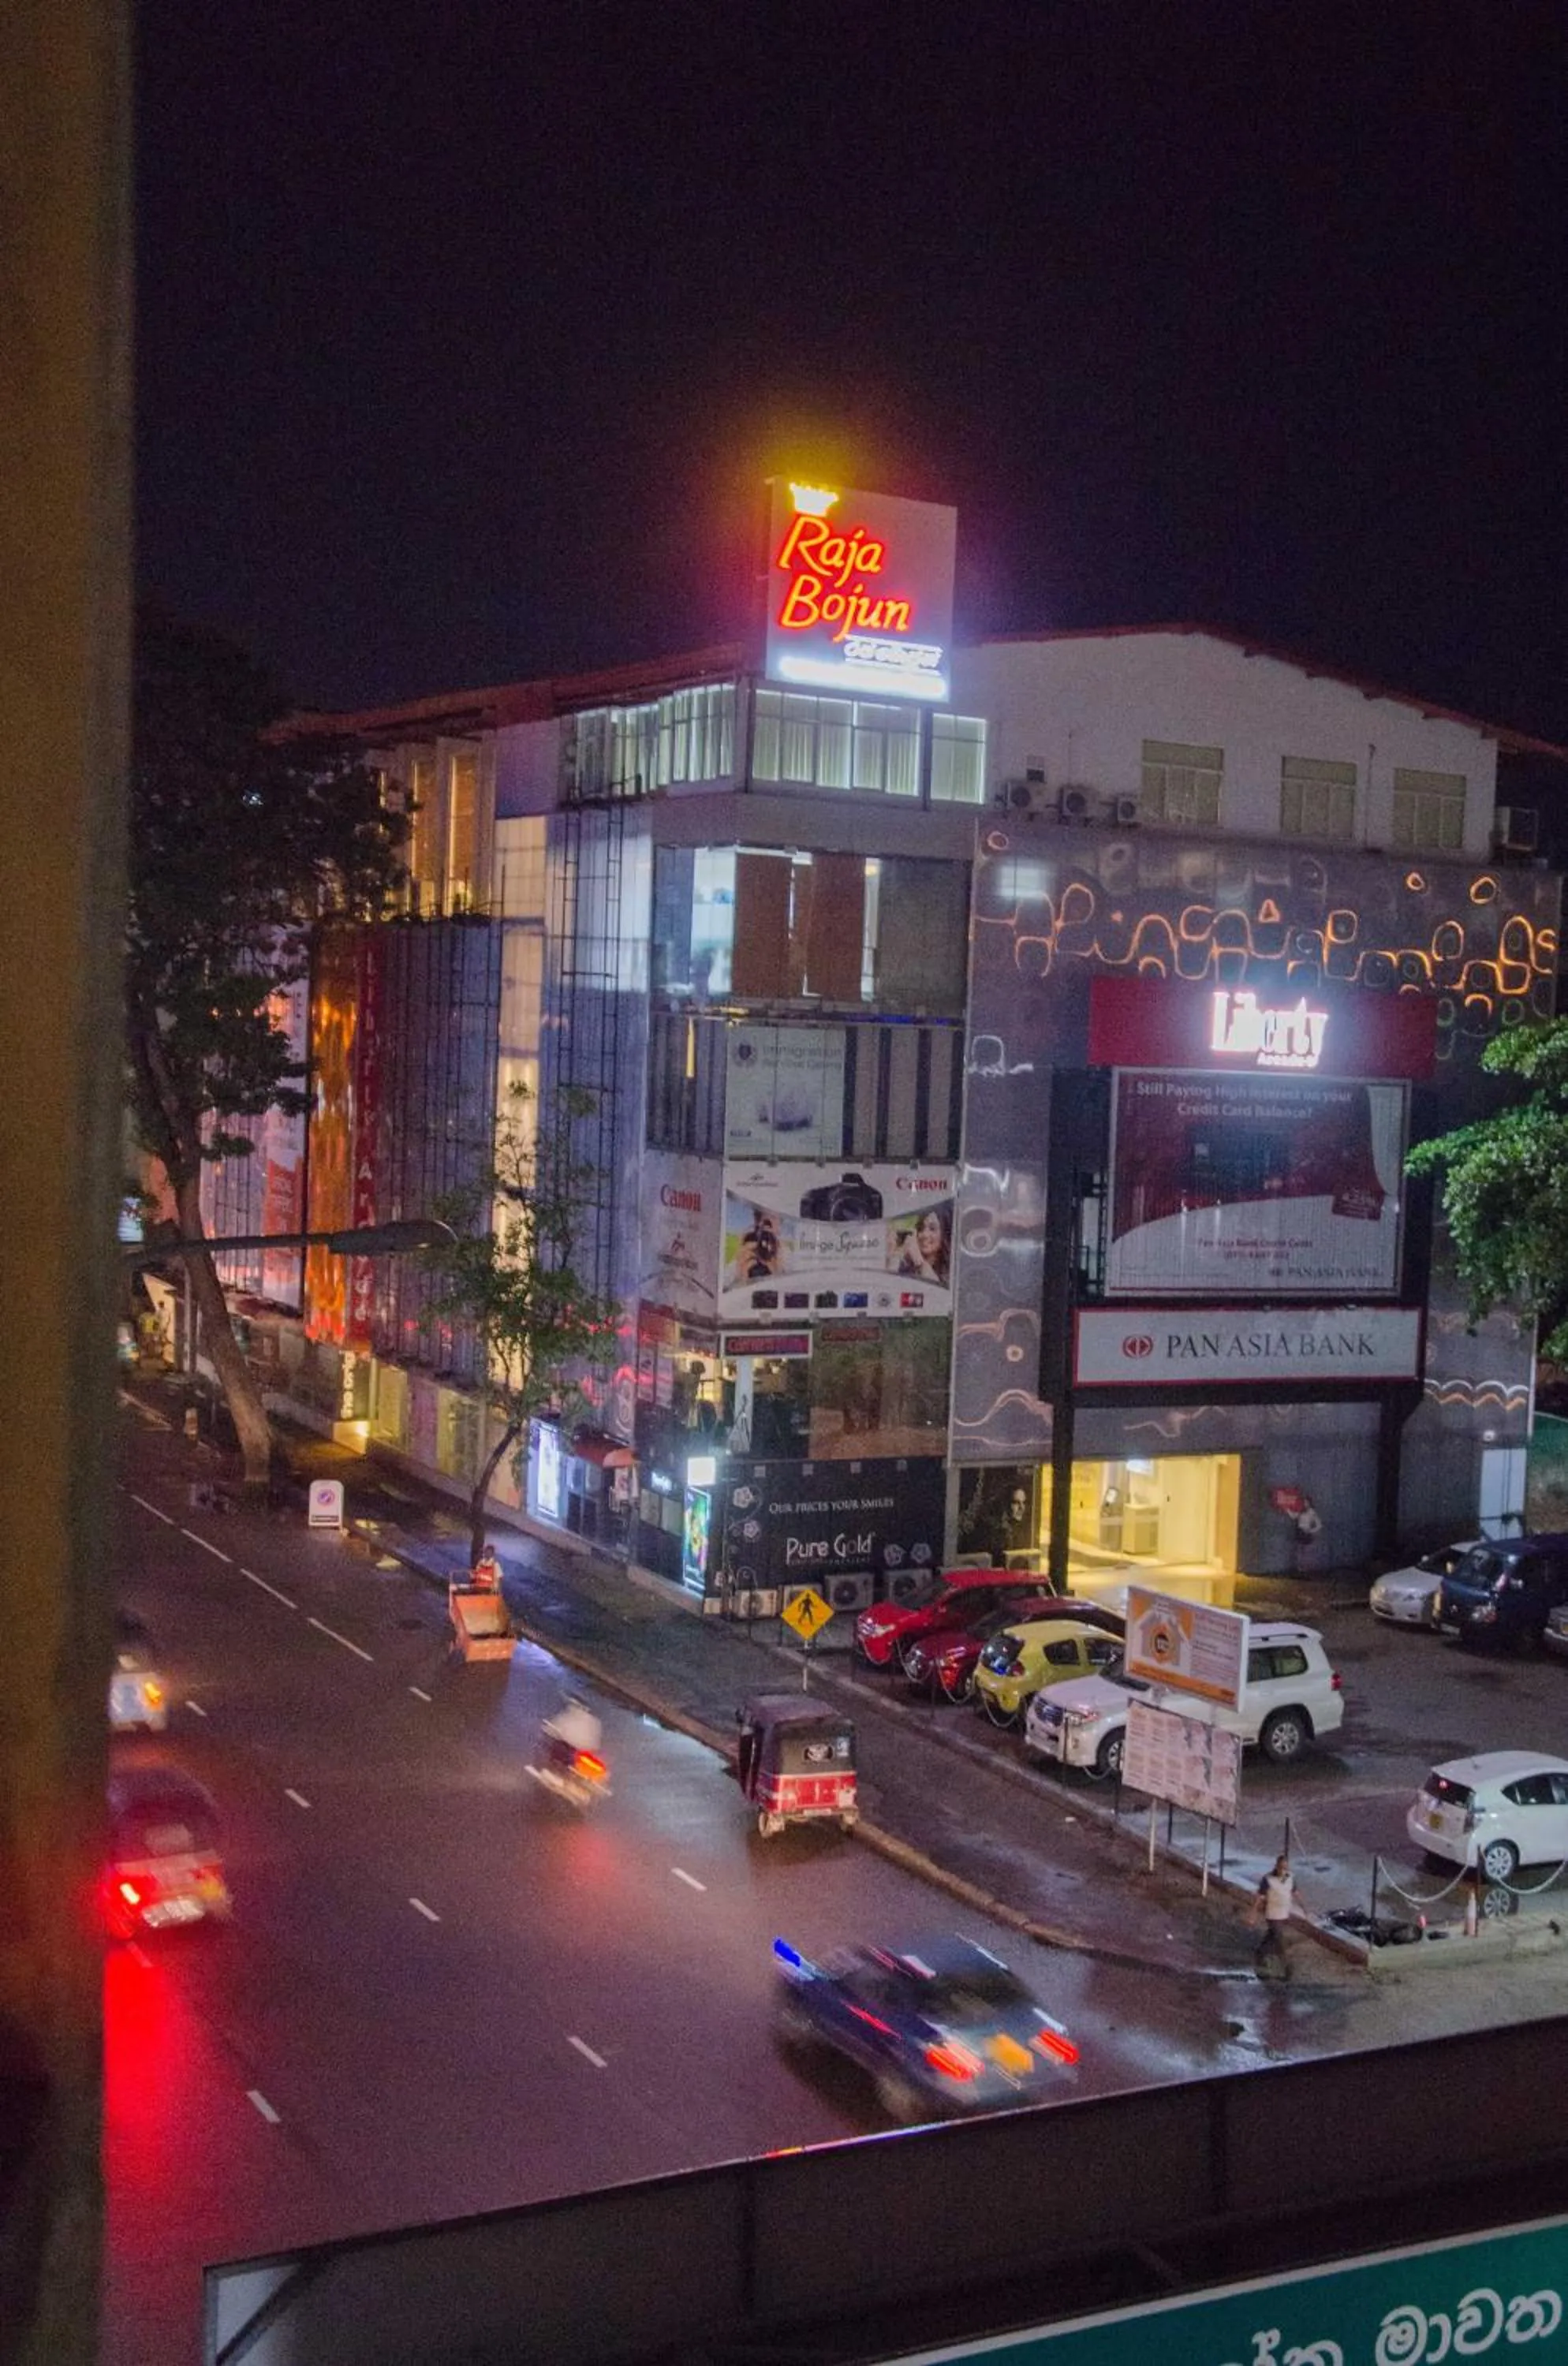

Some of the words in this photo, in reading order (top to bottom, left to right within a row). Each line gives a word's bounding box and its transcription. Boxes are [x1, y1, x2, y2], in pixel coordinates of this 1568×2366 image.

[779, 515, 883, 588] Raja
[780, 574, 910, 644] Bojun
[1137, 1080, 1163, 1095] Still
[1167, 1082, 1211, 1100] Paying
[1177, 1102, 1219, 1116] Credit
[1222, 1103, 1252, 1117] Card
[896, 1177, 948, 1191] Canon
[660, 1184, 702, 1212] Canon
[1165, 1334, 1221, 1358] PAN
[1225, 1333, 1293, 1358] ASIA
[1297, 1333, 1376, 1357] BANK
[795, 1501, 828, 1513] PRICES
[831, 1499, 858, 1511] YOUR
[861, 1498, 894, 1511] SMILES
[786, 1537, 829, 1566] Pure
[833, 1532, 872, 1558] Gold
